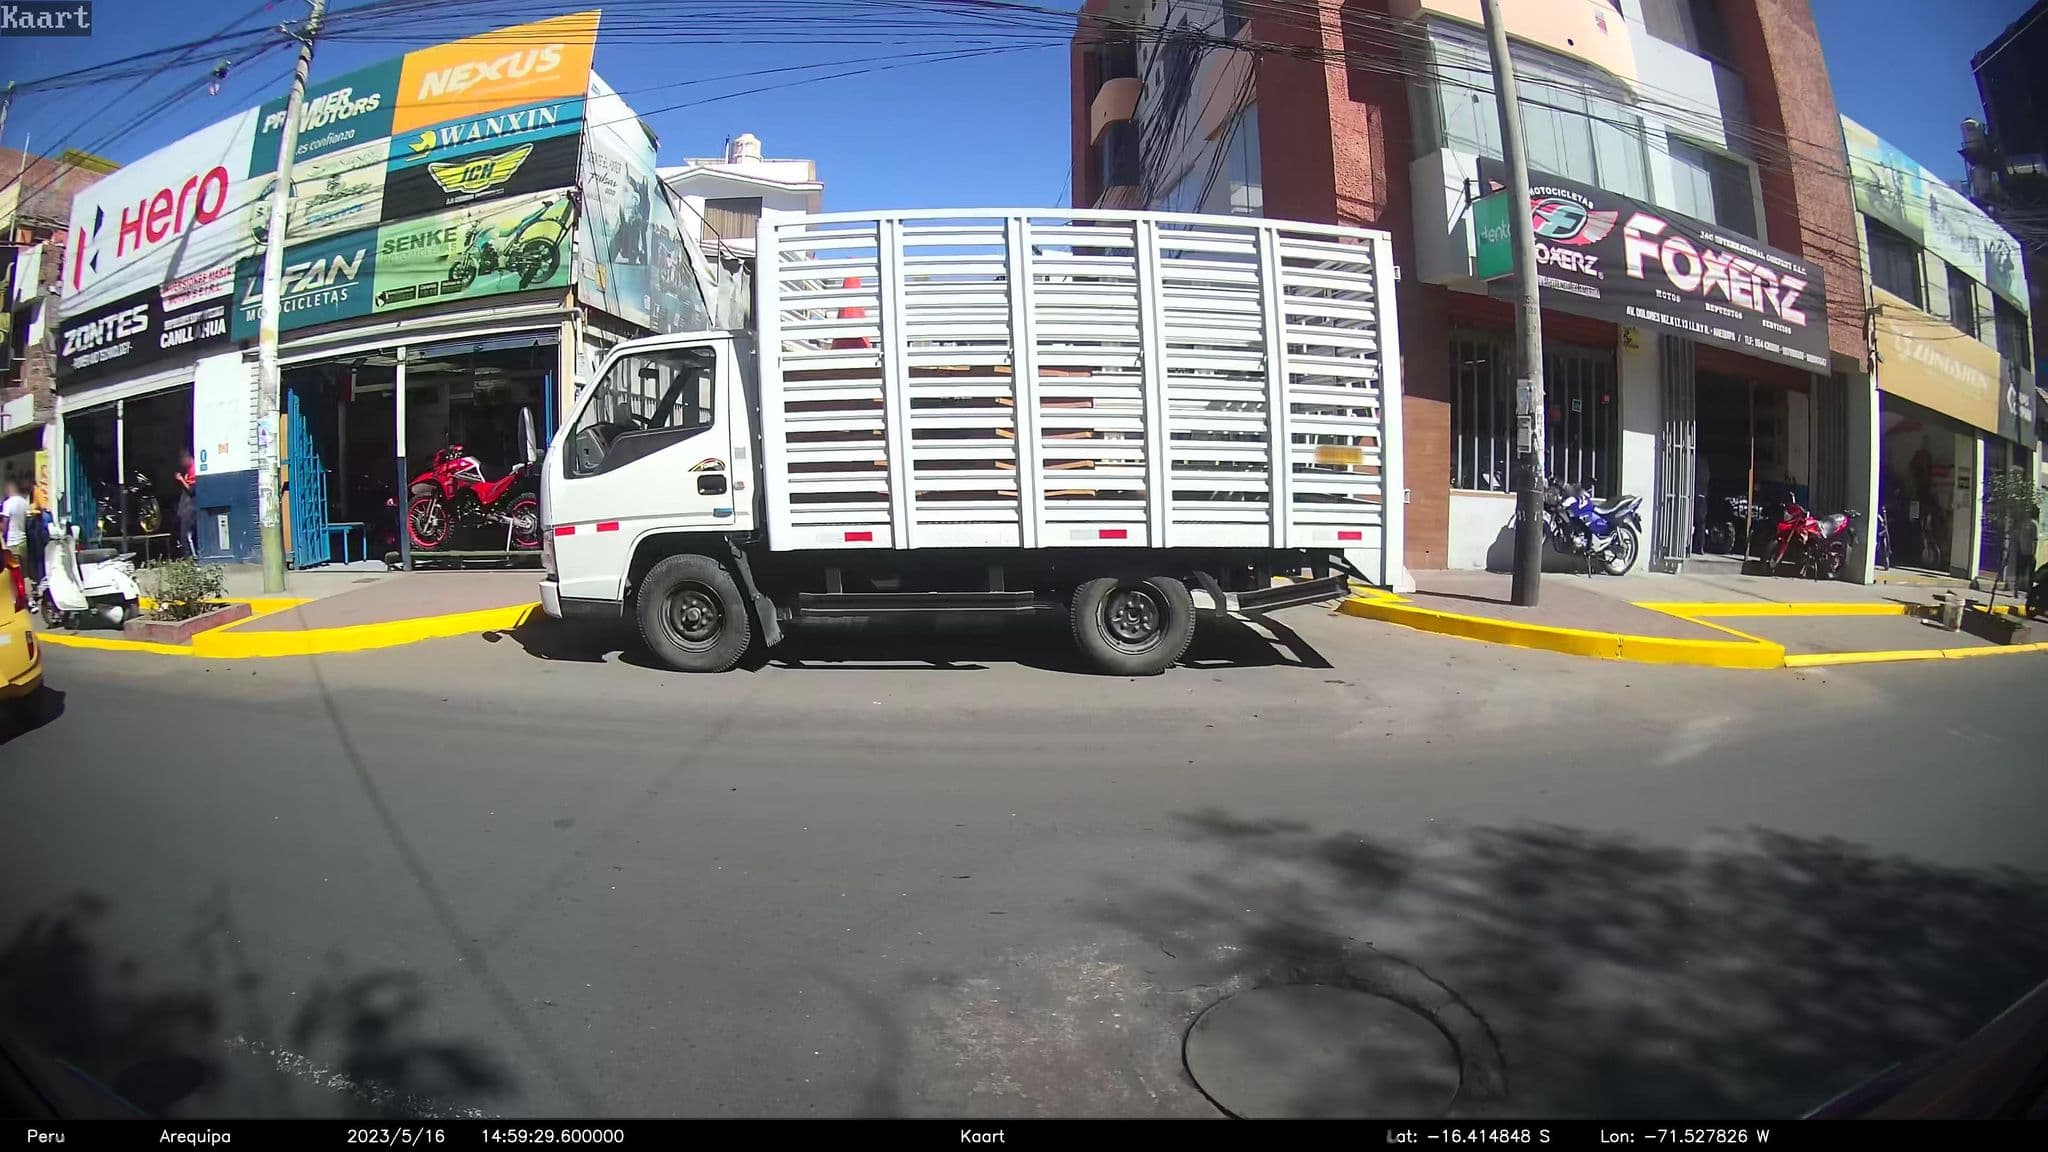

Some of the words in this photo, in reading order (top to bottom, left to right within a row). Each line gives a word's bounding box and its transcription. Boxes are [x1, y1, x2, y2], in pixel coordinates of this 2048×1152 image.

[418, 44, 565, 100] NEXUS
[299, 93, 382, 133] MOTORS
[441, 105, 561, 147] WANXIN
[309, 129, 355, 150] confianza
[1529, 186, 1594, 210] MOTOCICLETAS
[382, 226, 458, 255] SENKE
[1535, 243, 1599, 277] OXERZ
[241, 249, 367, 306] LFAN
[1624, 212, 1808, 328] FOXERZ
[62, 304, 149, 356] ZONTES
